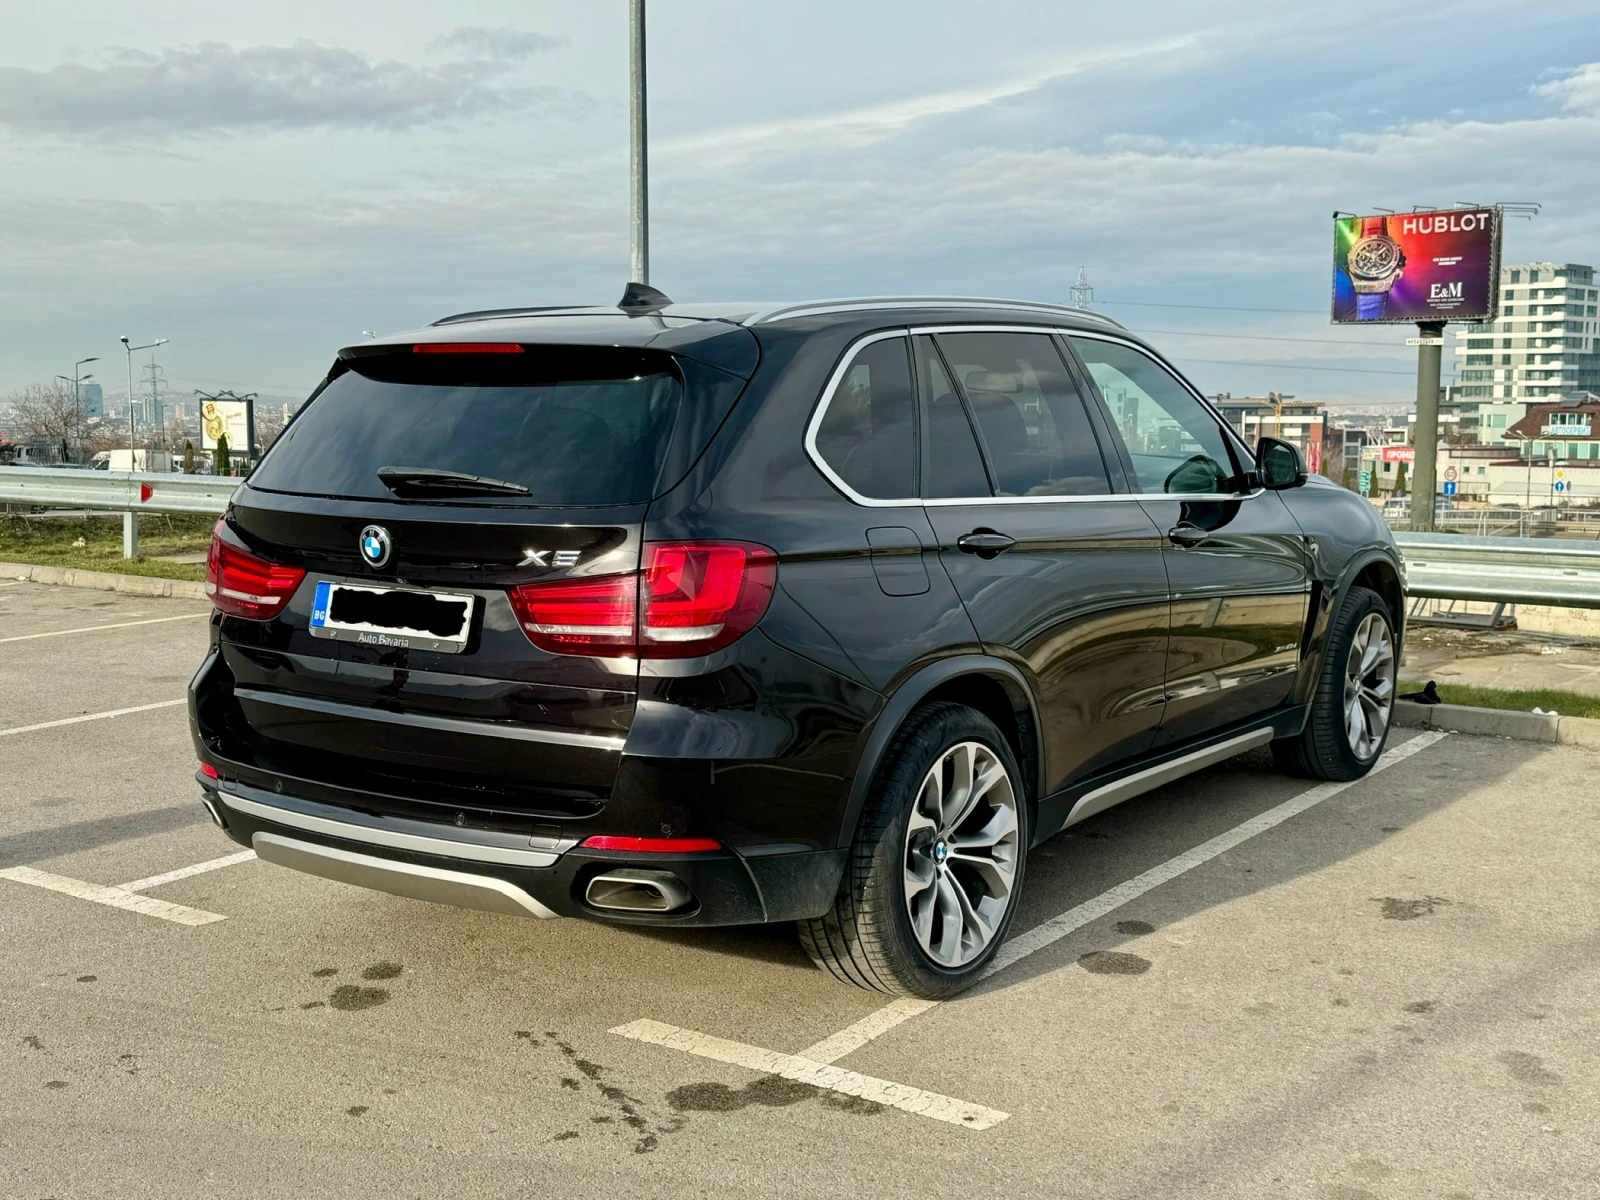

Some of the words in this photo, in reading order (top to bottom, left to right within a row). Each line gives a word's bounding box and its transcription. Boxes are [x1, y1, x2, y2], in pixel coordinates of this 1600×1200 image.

[1403, 213, 1489, 235] HUBLOT
[1430, 282, 1462, 298] E&M
[516, 550, 581, 567] X5
[314, 609, 326, 620] BG
[358, 632, 377, 644] Auto
[378, 634, 409, 648] Bavaria
